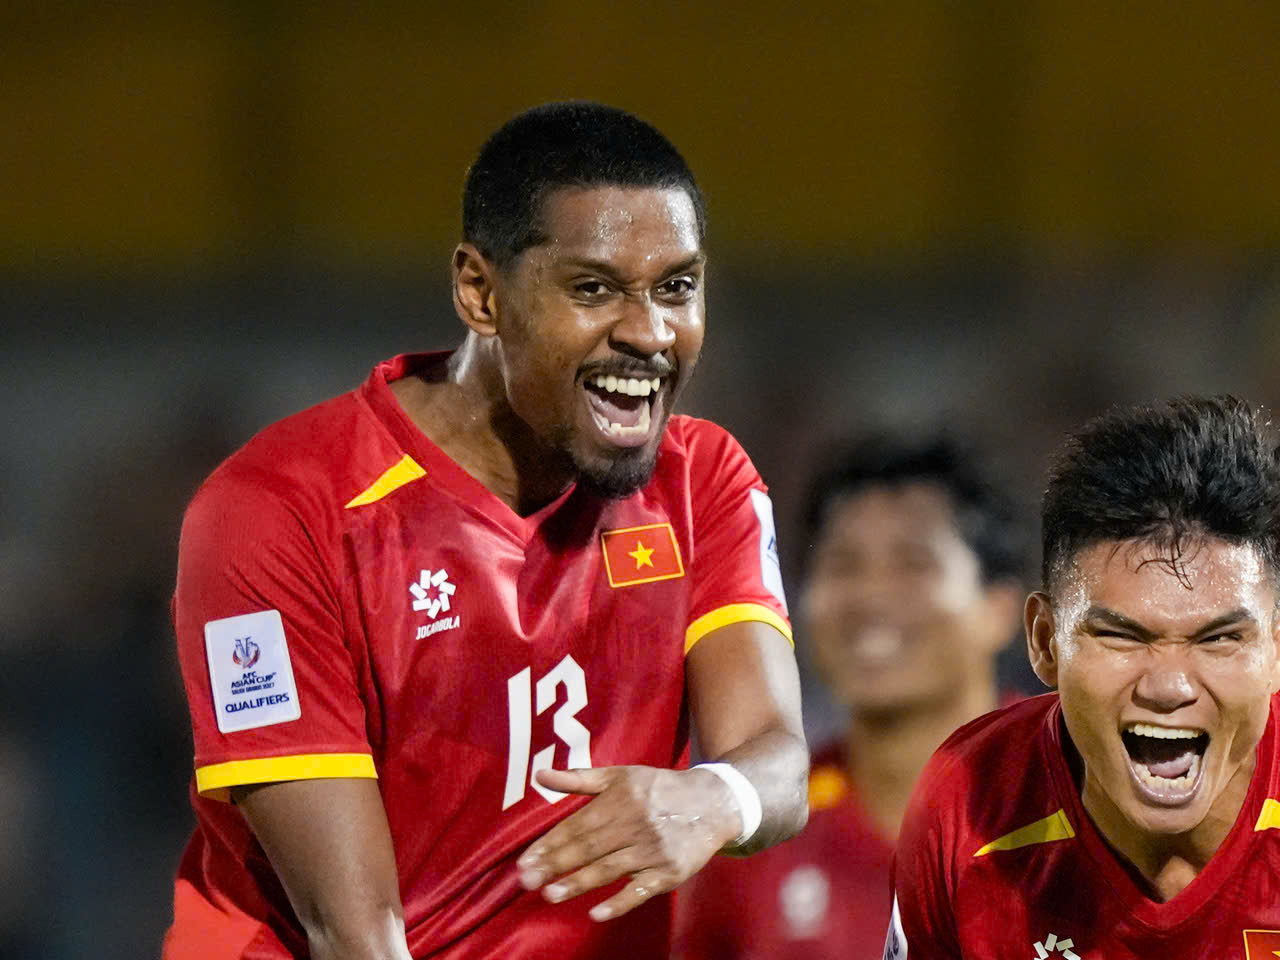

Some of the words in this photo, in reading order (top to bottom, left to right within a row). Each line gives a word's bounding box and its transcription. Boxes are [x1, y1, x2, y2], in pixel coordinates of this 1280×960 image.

[231, 678, 255, 688] ASIAN
[225, 692, 290, 713] QUALIFIERS
[502, 653, 593, 812] 13
